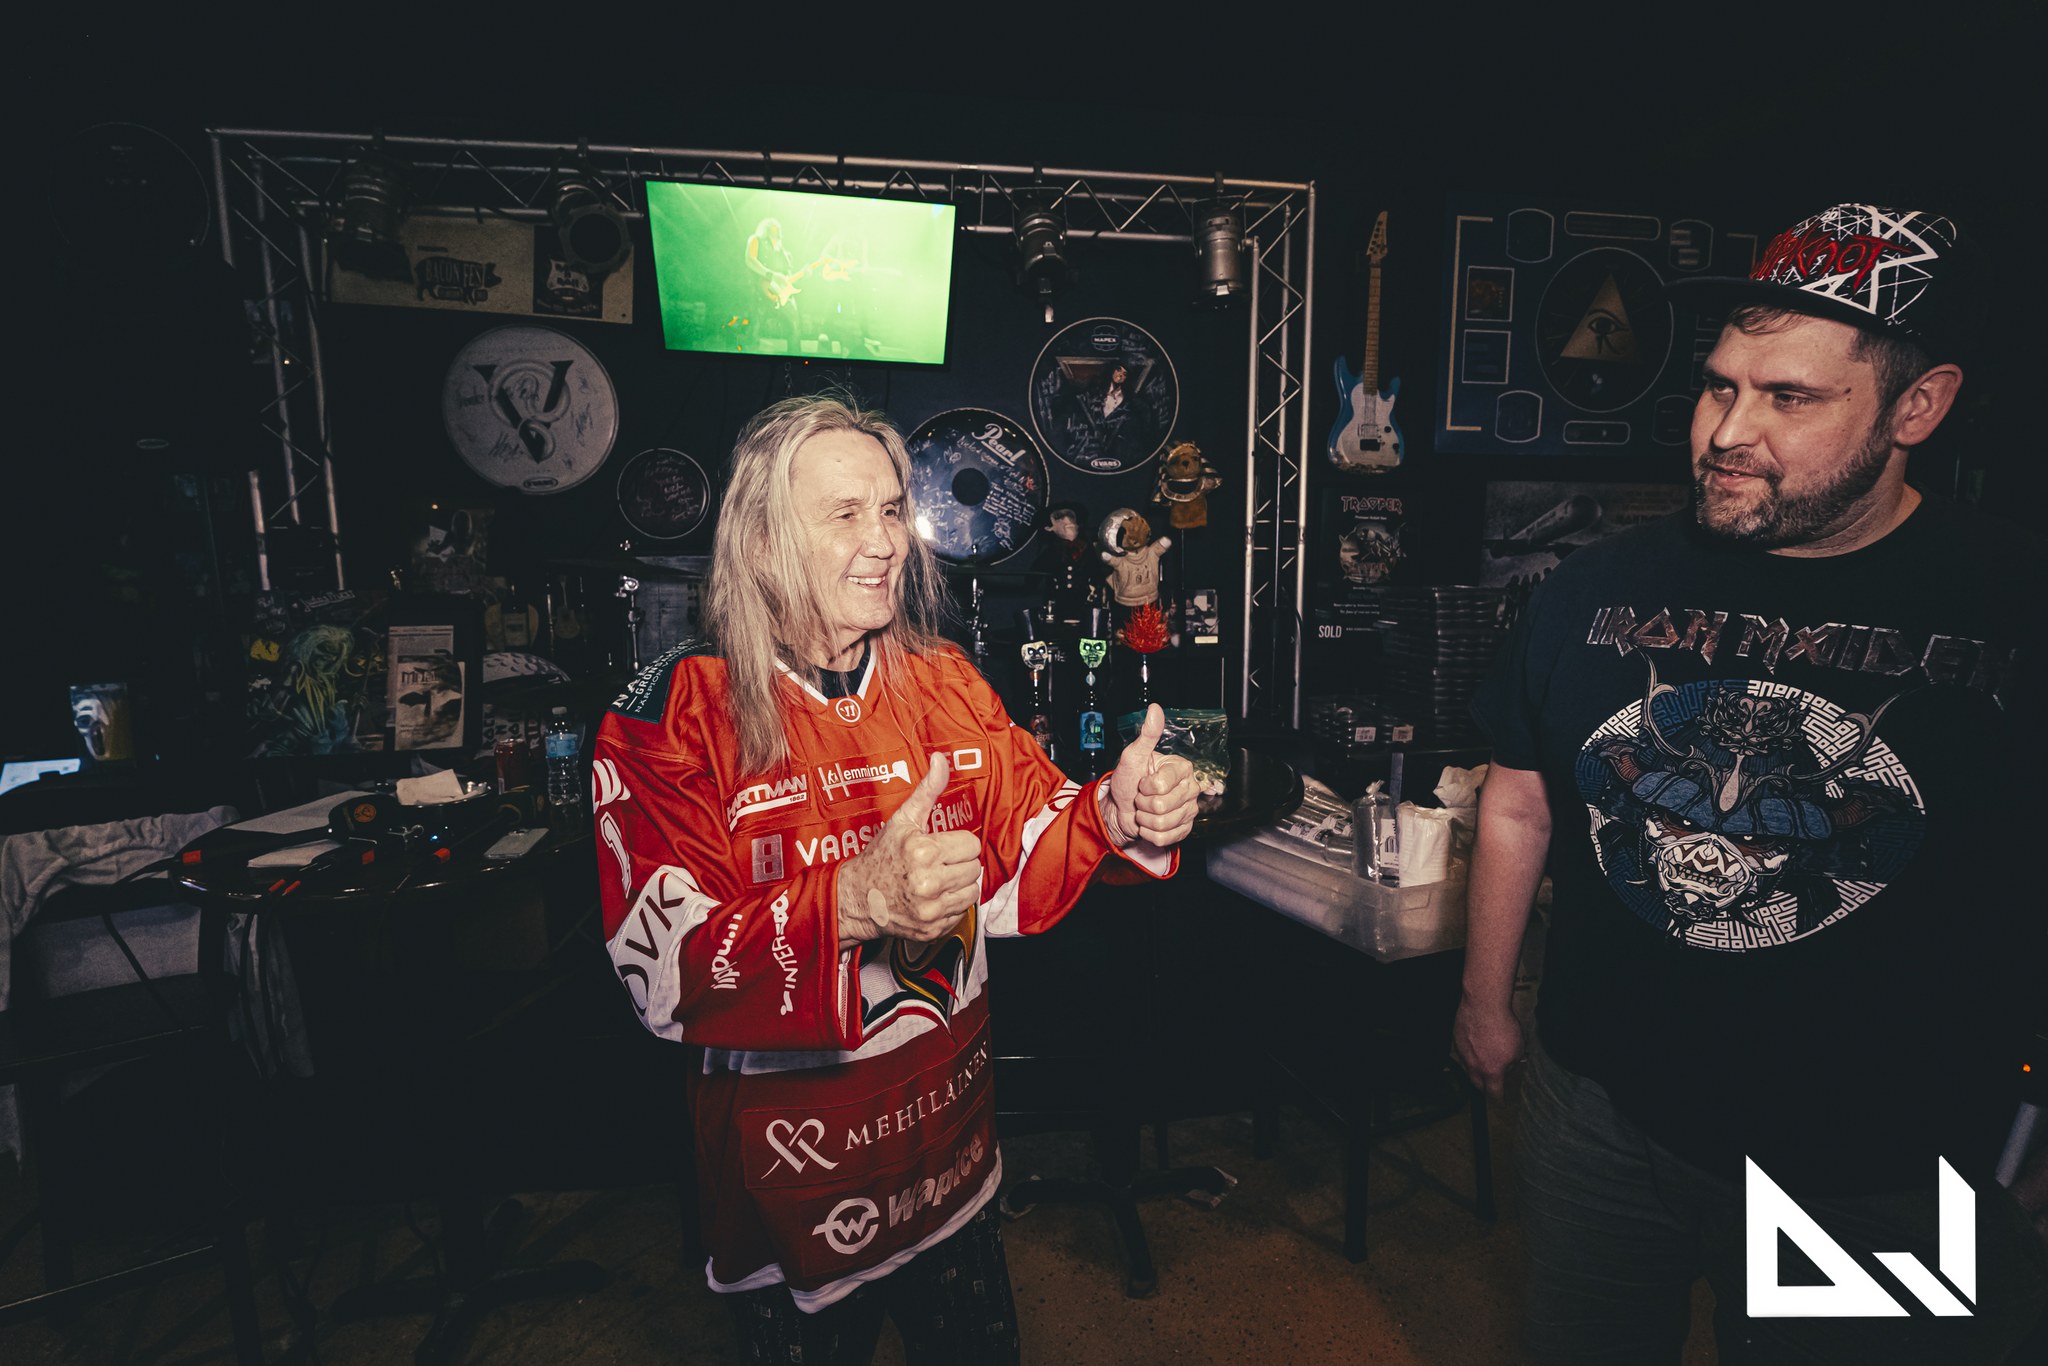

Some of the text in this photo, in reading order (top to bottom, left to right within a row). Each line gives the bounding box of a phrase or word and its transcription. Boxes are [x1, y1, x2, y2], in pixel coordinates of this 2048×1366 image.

[971, 423, 1026, 466] Pearl
[1318, 625, 1342, 639] SOLD
[1586, 606, 1728, 666] IRON
[845, 1041, 988, 1151] MEHILÄINEN
[888, 1133, 984, 1229] Wapice
